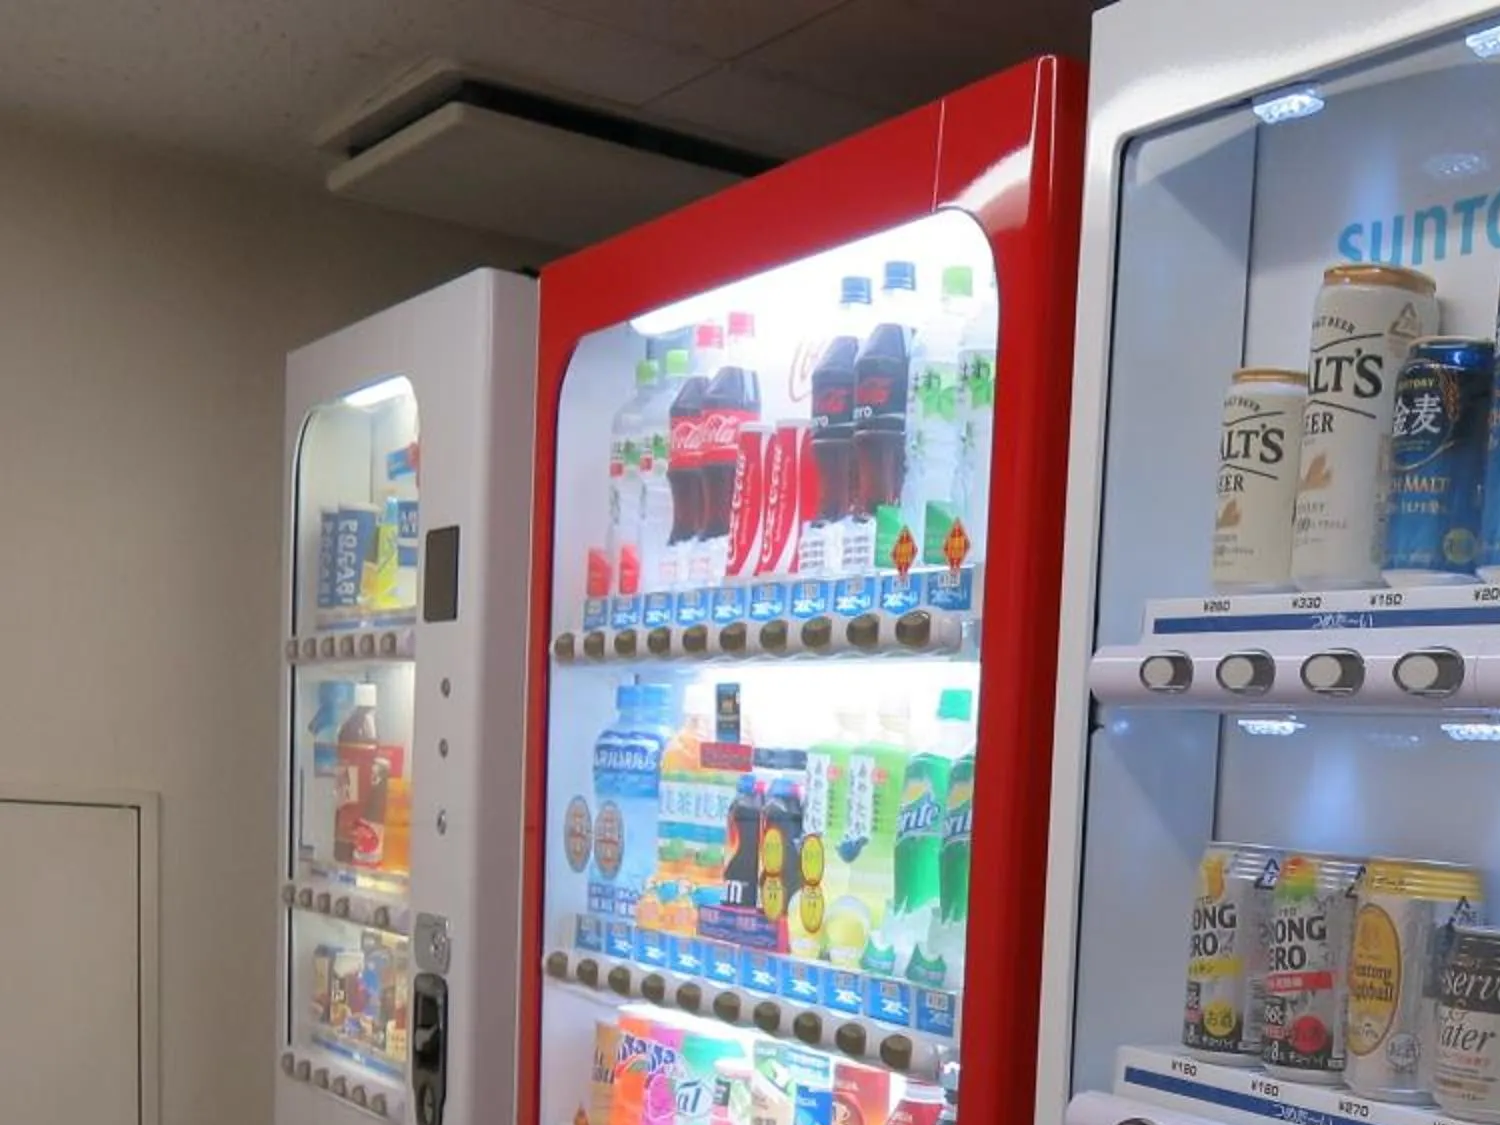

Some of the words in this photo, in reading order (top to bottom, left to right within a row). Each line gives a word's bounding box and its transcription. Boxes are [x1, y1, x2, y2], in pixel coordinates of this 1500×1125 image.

[1308, 347, 1385, 399] LT'S
[1303, 411, 1335, 435] EER
[1219, 422, 1286, 465] LT'S
[1218, 475, 1245, 494] EER
[1192, 903, 1238, 931] ONG
[1440, 1024, 1496, 1052] ater
